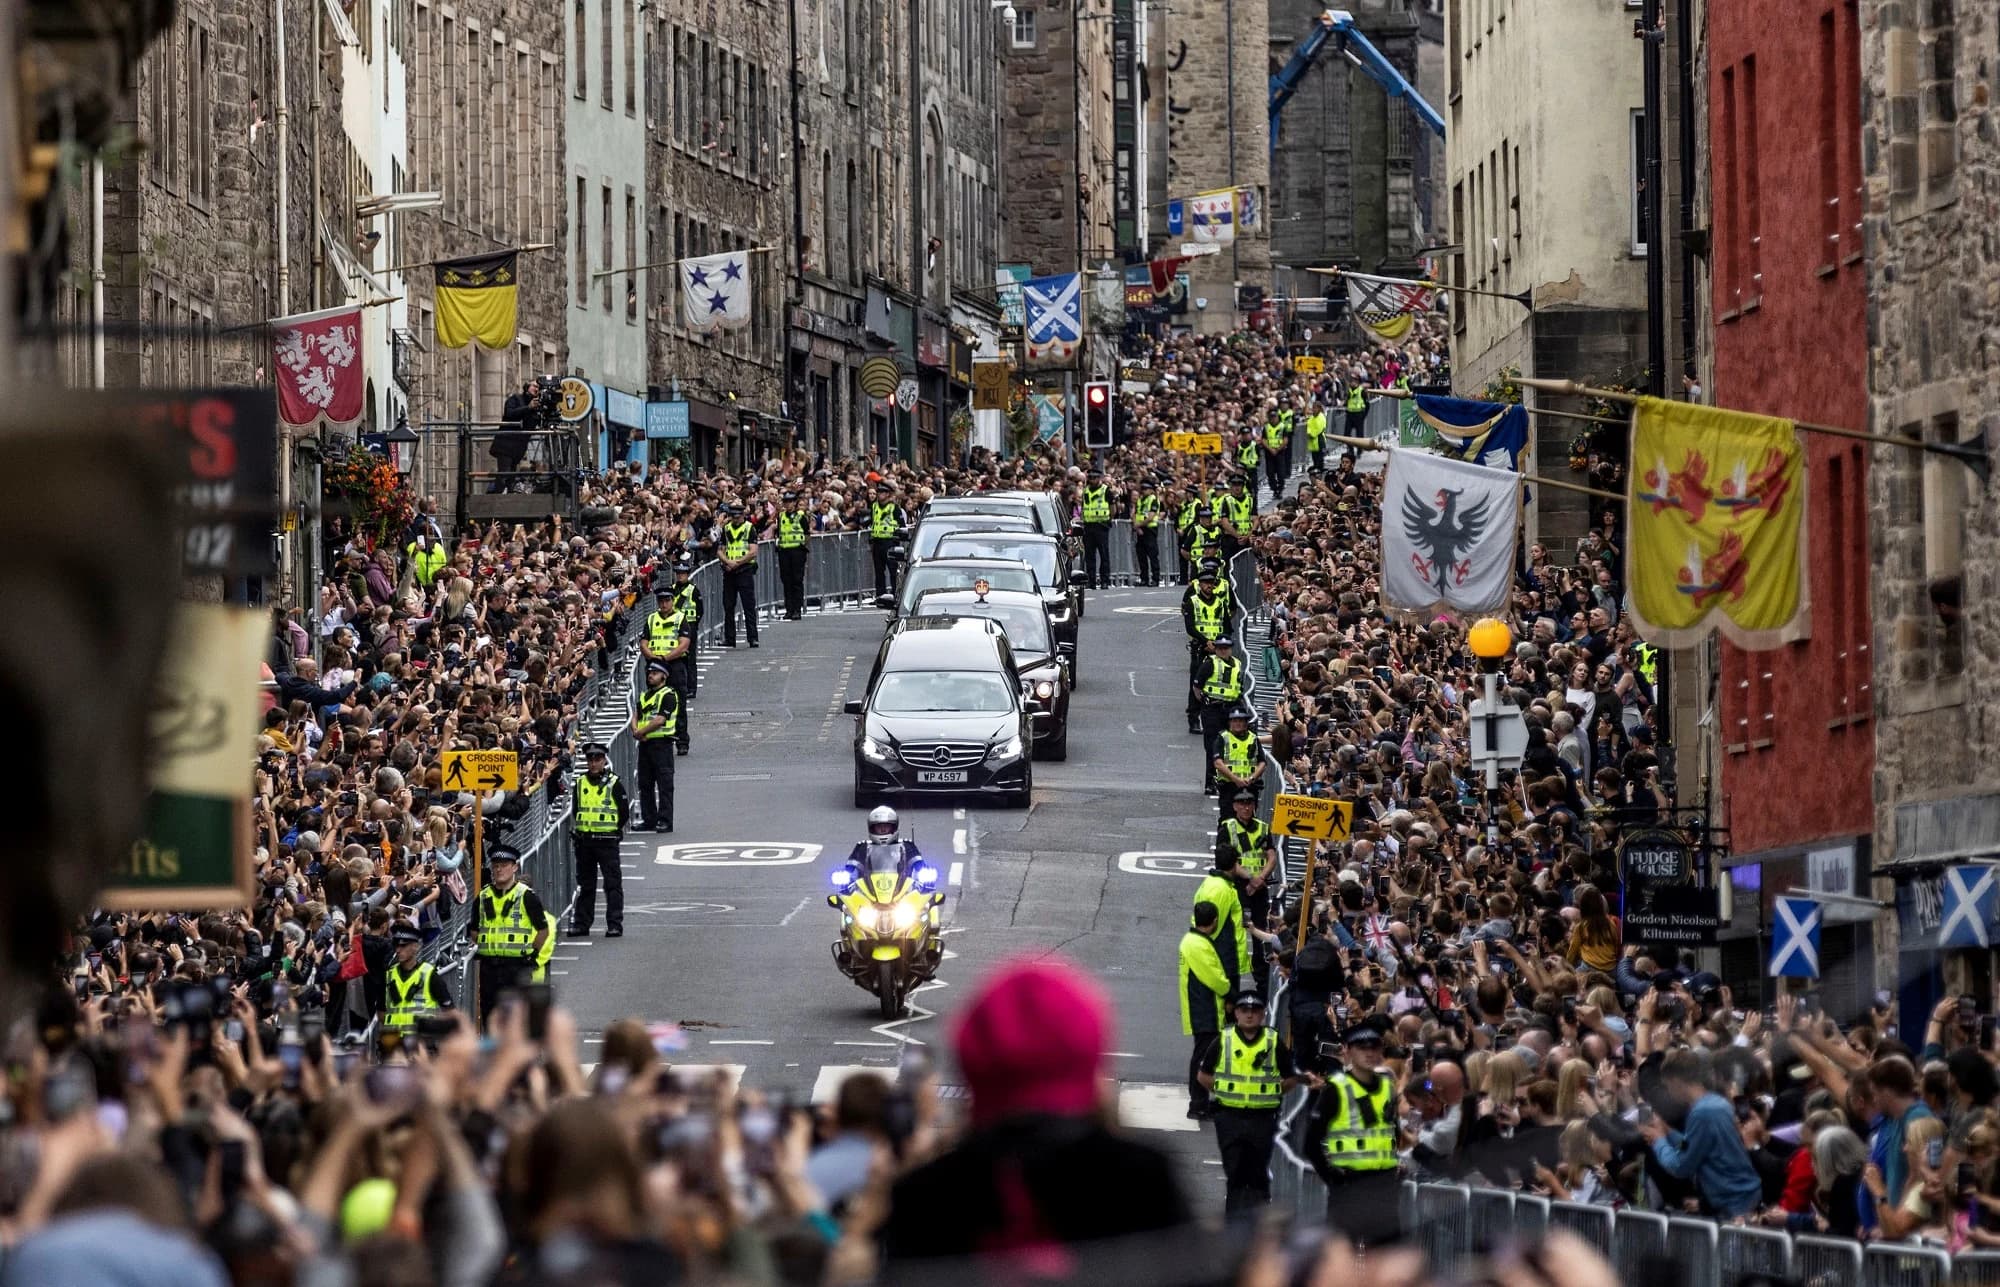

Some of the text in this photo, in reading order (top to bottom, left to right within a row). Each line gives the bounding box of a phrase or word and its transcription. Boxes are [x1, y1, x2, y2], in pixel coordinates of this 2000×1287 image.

[466, 753, 516, 762] CROSSING
[477, 764, 505, 773] POINT
[924, 772, 961, 781] WP 4597
[1278, 797, 1329, 811] CROSSING
[1287, 808, 1317, 820] POINT
[1629, 850, 1679, 865] FUDGE
[1626, 913, 1718, 926] Gordon Nicolson
[1642, 928, 1702, 941] Kiltmakers
